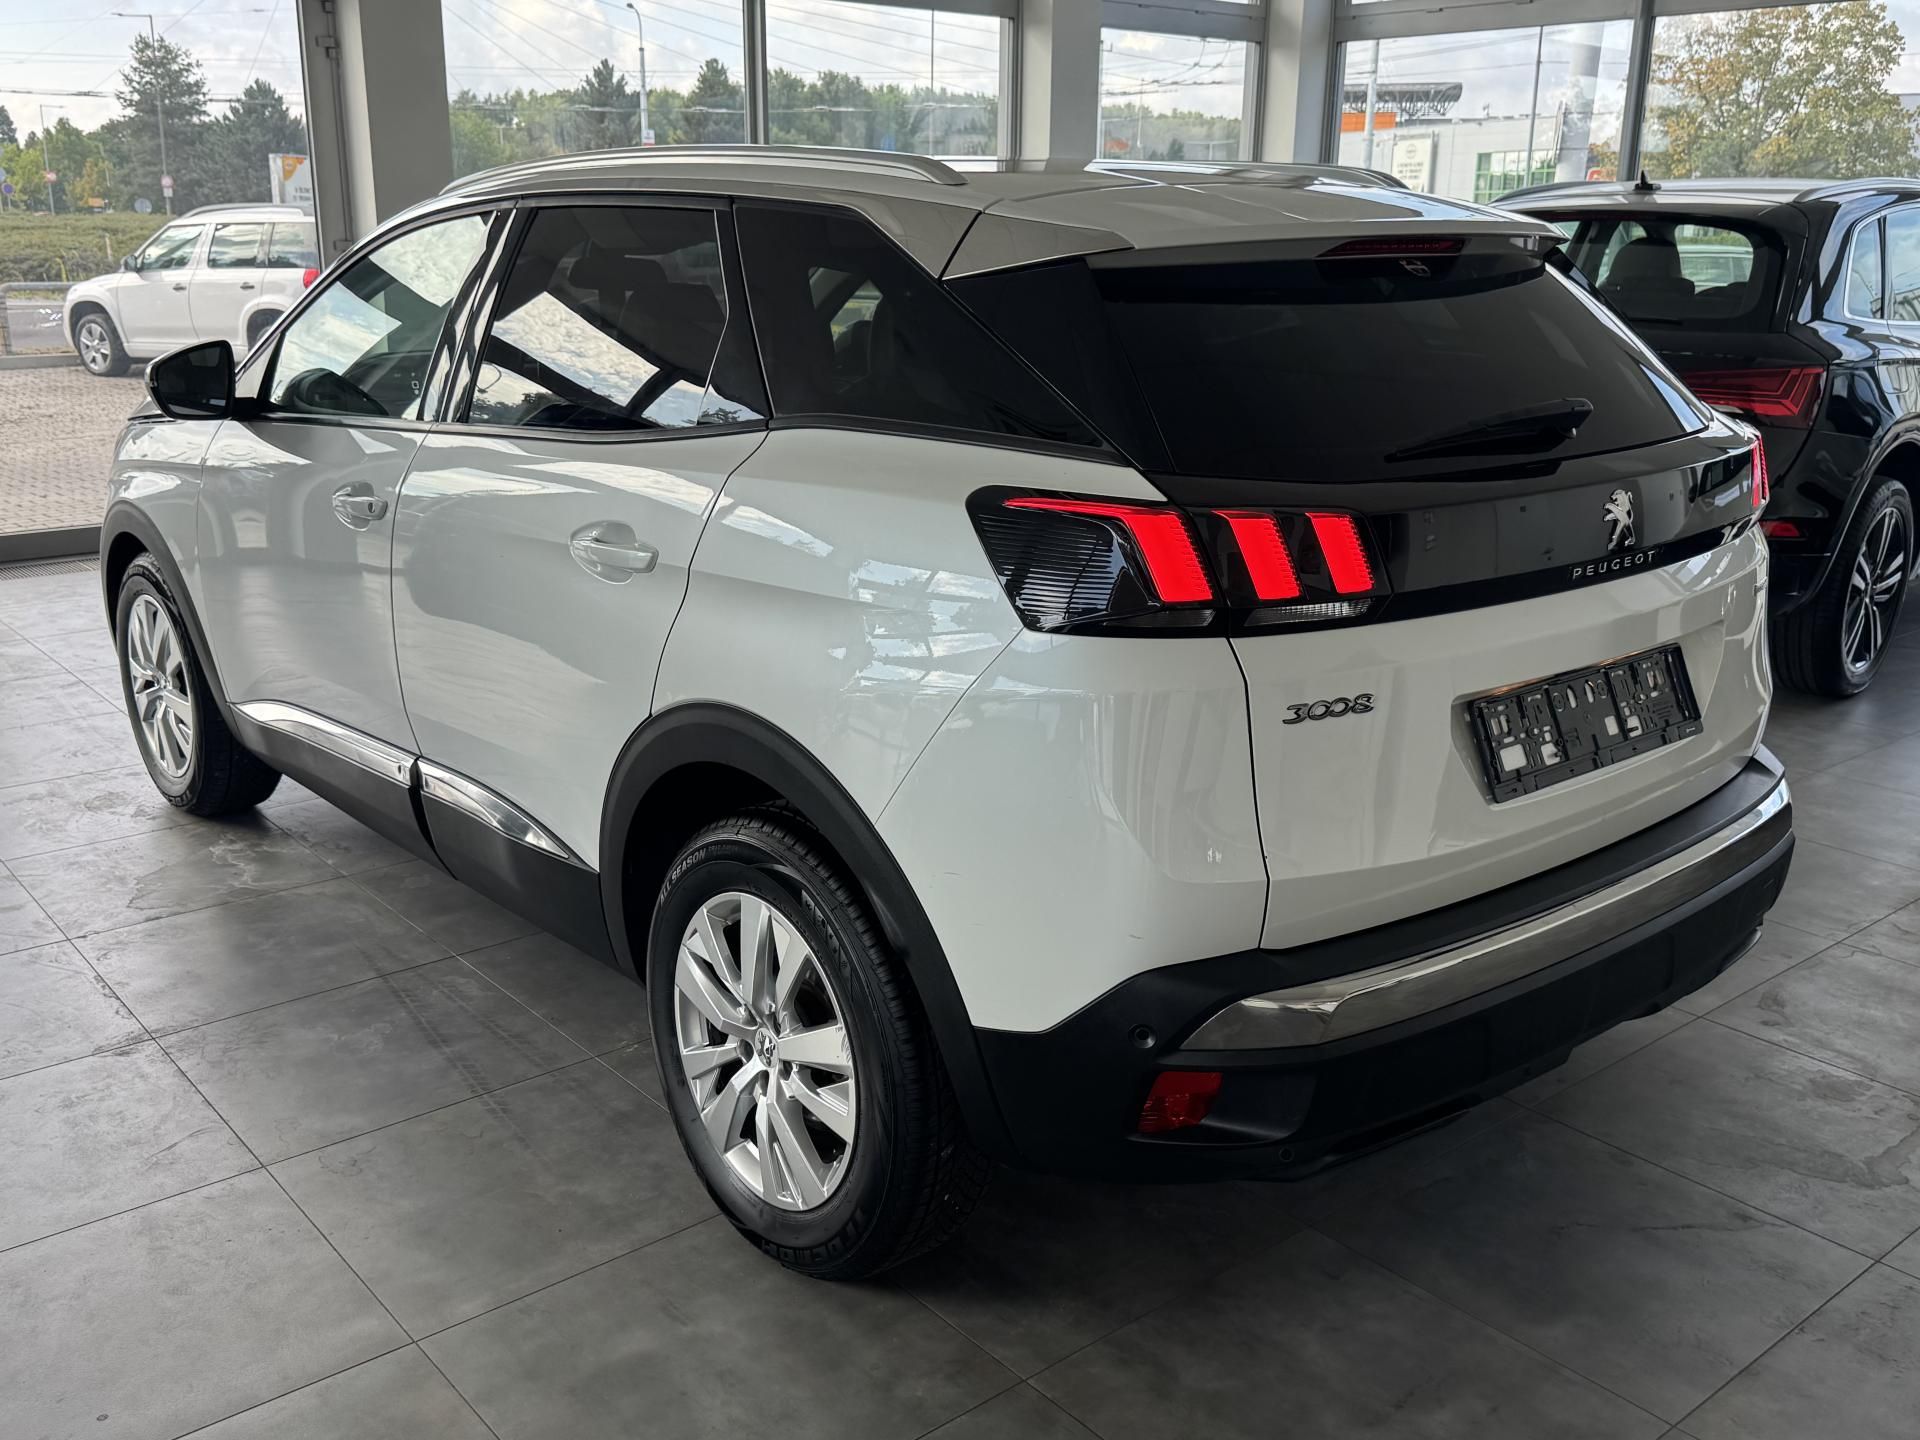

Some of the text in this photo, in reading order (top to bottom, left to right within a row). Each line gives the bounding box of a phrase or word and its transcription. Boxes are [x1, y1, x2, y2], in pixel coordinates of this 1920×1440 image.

[1572, 550, 1656, 580] PEUGEOT
[1282, 693, 1375, 725] 3008
[660, 847, 707, 906] ALL SEASON
